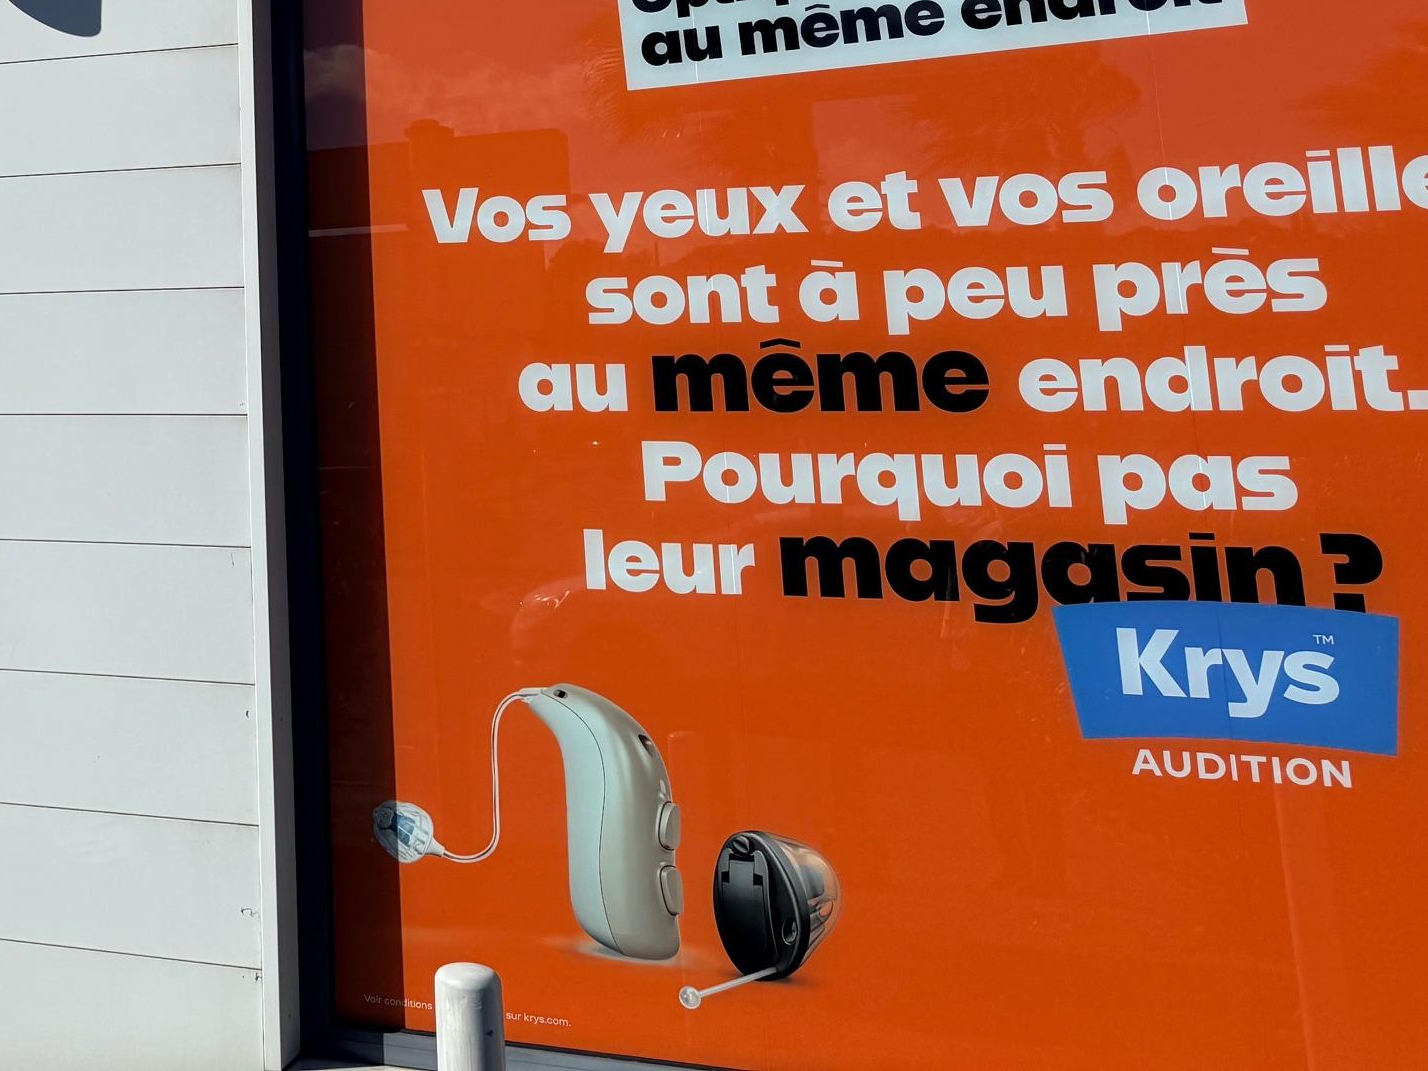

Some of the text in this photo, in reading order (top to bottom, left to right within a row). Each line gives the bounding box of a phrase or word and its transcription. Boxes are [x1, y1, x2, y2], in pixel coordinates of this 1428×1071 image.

[641, 25, 723, 67] au
[740, 1, 945, 56] même
[422, 187, 572, 245] Vos
[600, 183, 808, 254] yeux
[827, 171, 922, 232] et
[938, 169, 1114, 228] vos
[586, 247, 1328, 335] sont à peu près
[518, 363, 629, 414] au
[652, 337, 990, 414] même
[641, 440, 1299, 525] Pourquoi pas
[582, 528, 756, 596] leur
[779, 532, 1307, 626] magasin
[1115, 627, 1340, 719] Krys
[1131, 748, 1353, 789] AUDITION
[363, 992, 433, 1010] Voir conditions
[506, 1012, 572, 1027] sur krys.com.
